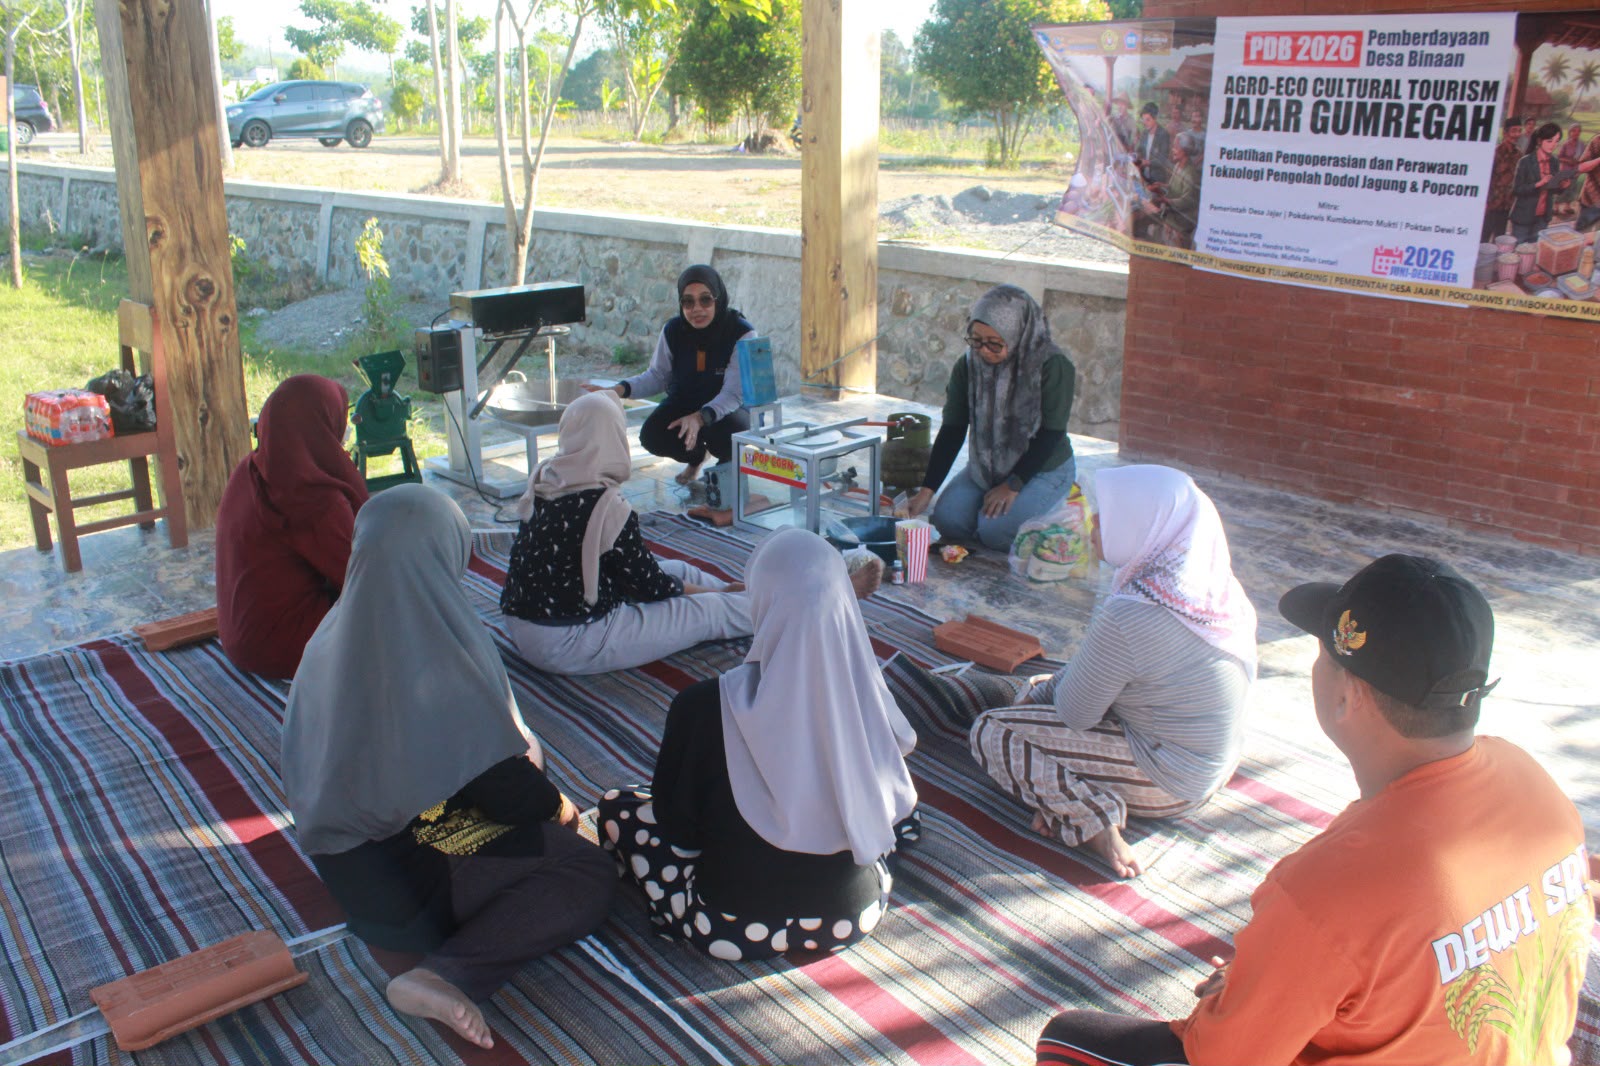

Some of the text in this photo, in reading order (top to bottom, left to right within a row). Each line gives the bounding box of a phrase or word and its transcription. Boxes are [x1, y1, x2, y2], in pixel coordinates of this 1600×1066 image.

[1250, 35, 1356, 62] PDB 2026
[1367, 30, 1490, 47] Pemberdayaan
[1366, 50, 1465, 68] Desa Binaan
[1224, 76, 1500, 102] AGRO-ECO CULTURAL TOURISM
[1220, 97, 1496, 142] JAJAR GUMREGAH
[1220, 147, 1468, 176] Pelatihan Pengoperasian dan Perawatan
[1210, 164, 1479, 197] Teknologi Pengolah Dodol Jagung & Popcorn
[1318, 202, 1340, 211] Mitra:
[1209, 204, 1468, 236] Pemerintah Desa Jajar Pokdarwis Kumbokarno Mukti Poktan Dewi Sri
[1404, 246, 1454, 271] 2026
[1168, 250, 1188, 261] JAWA
[1190, 254, 1213, 266] TIMUR
[1219, 260, 1266, 275] UNIVERSITAS
[1268, 268, 1328, 283] TULUNGAGUNG
[1334, 276, 1388, 290] PEMERINTAH
[1390, 283, 1411, 293] DESA
[1413, 287, 1440, 297] JAJAR
[1447, 290, 1503, 305] POKDARWIS
[1506, 298, 1578, 313] KUMBOKARNO
[1389, 266, 1458, 283] JUNI-DESEMBER
[753, 451, 795, 473] POP CORN
[1431, 884, 1539, 985] DEWI
